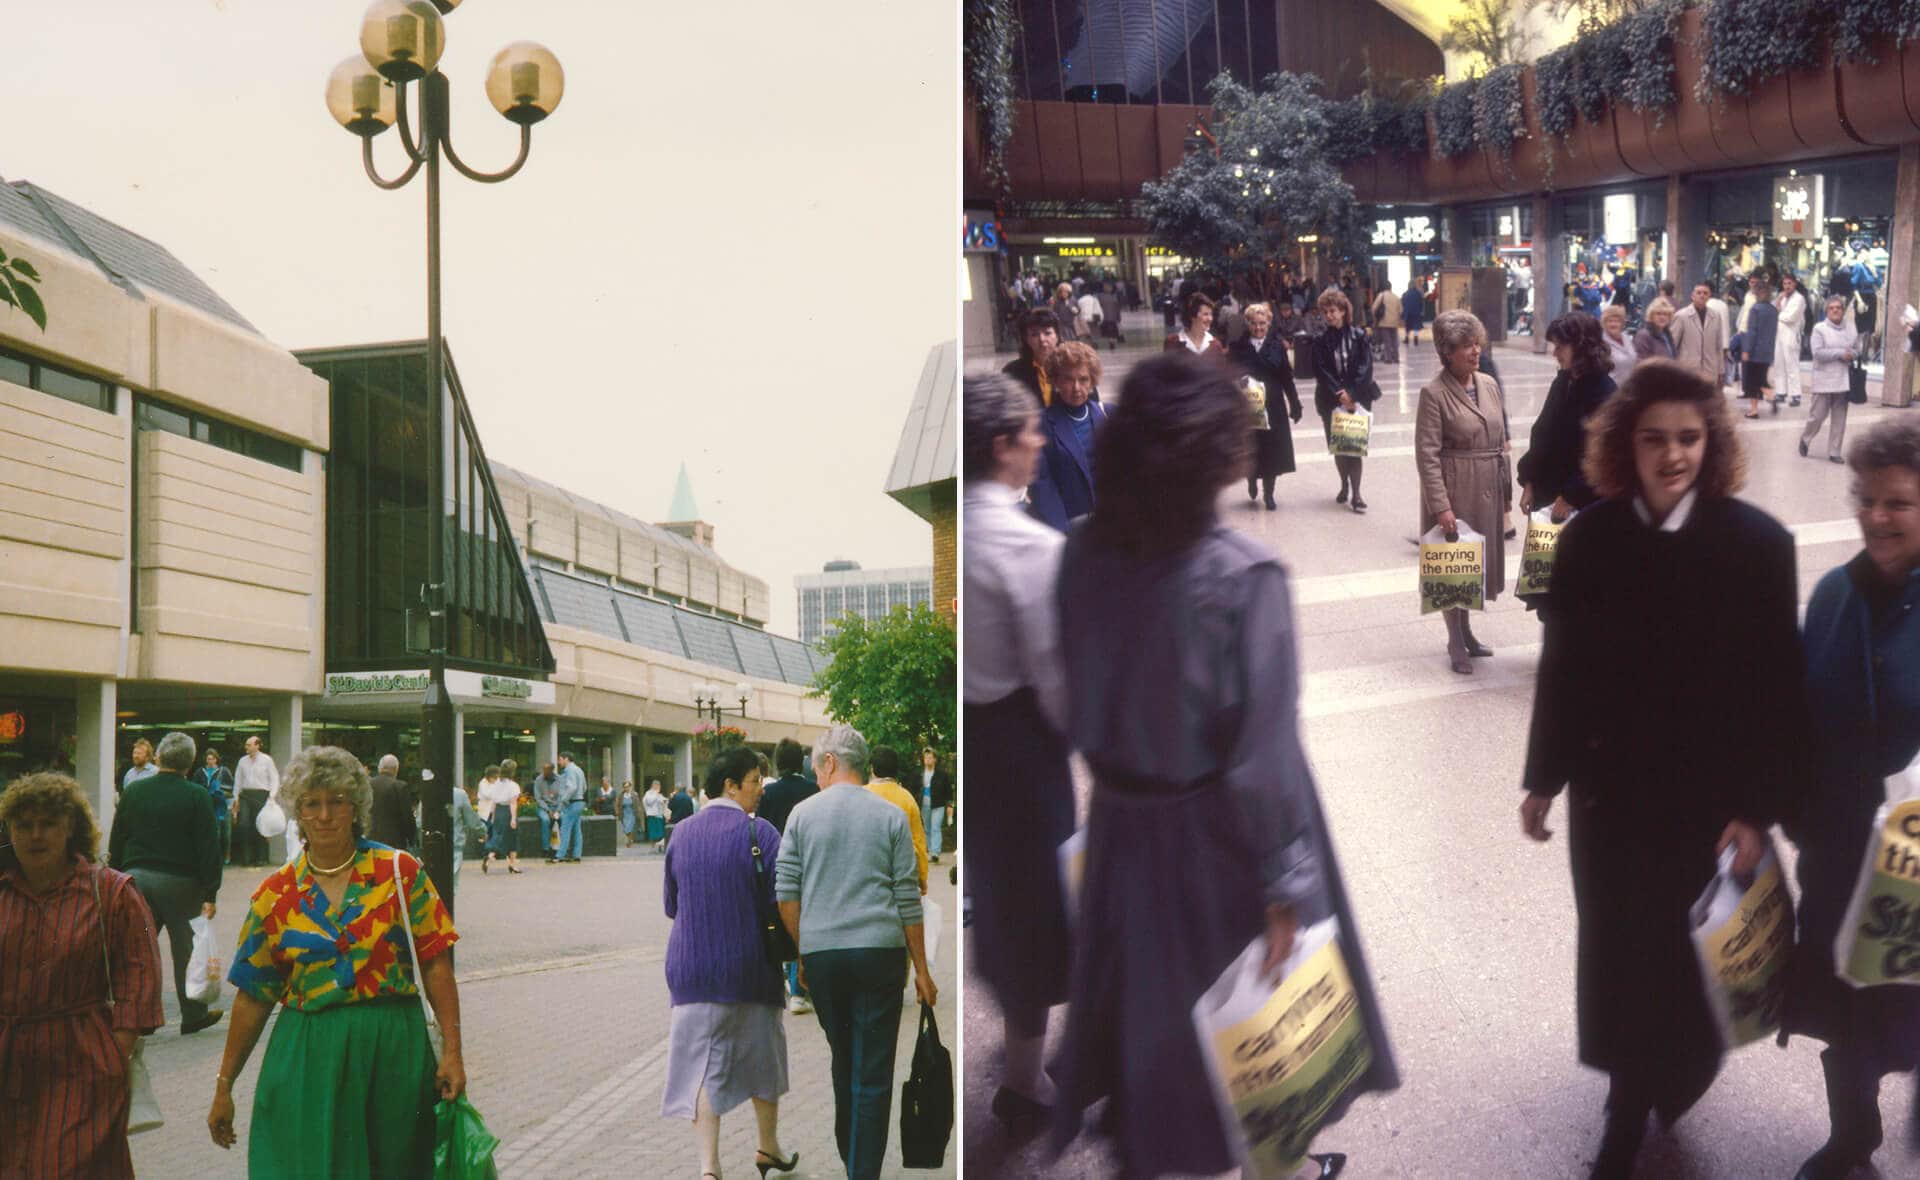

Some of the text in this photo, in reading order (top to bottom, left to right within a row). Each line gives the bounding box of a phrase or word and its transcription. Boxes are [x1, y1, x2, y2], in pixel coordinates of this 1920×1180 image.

[1059, 247, 1102, 256] MARKS
[1425, 549, 1475, 561] carrying
[1423, 564, 1481, 574] the name
